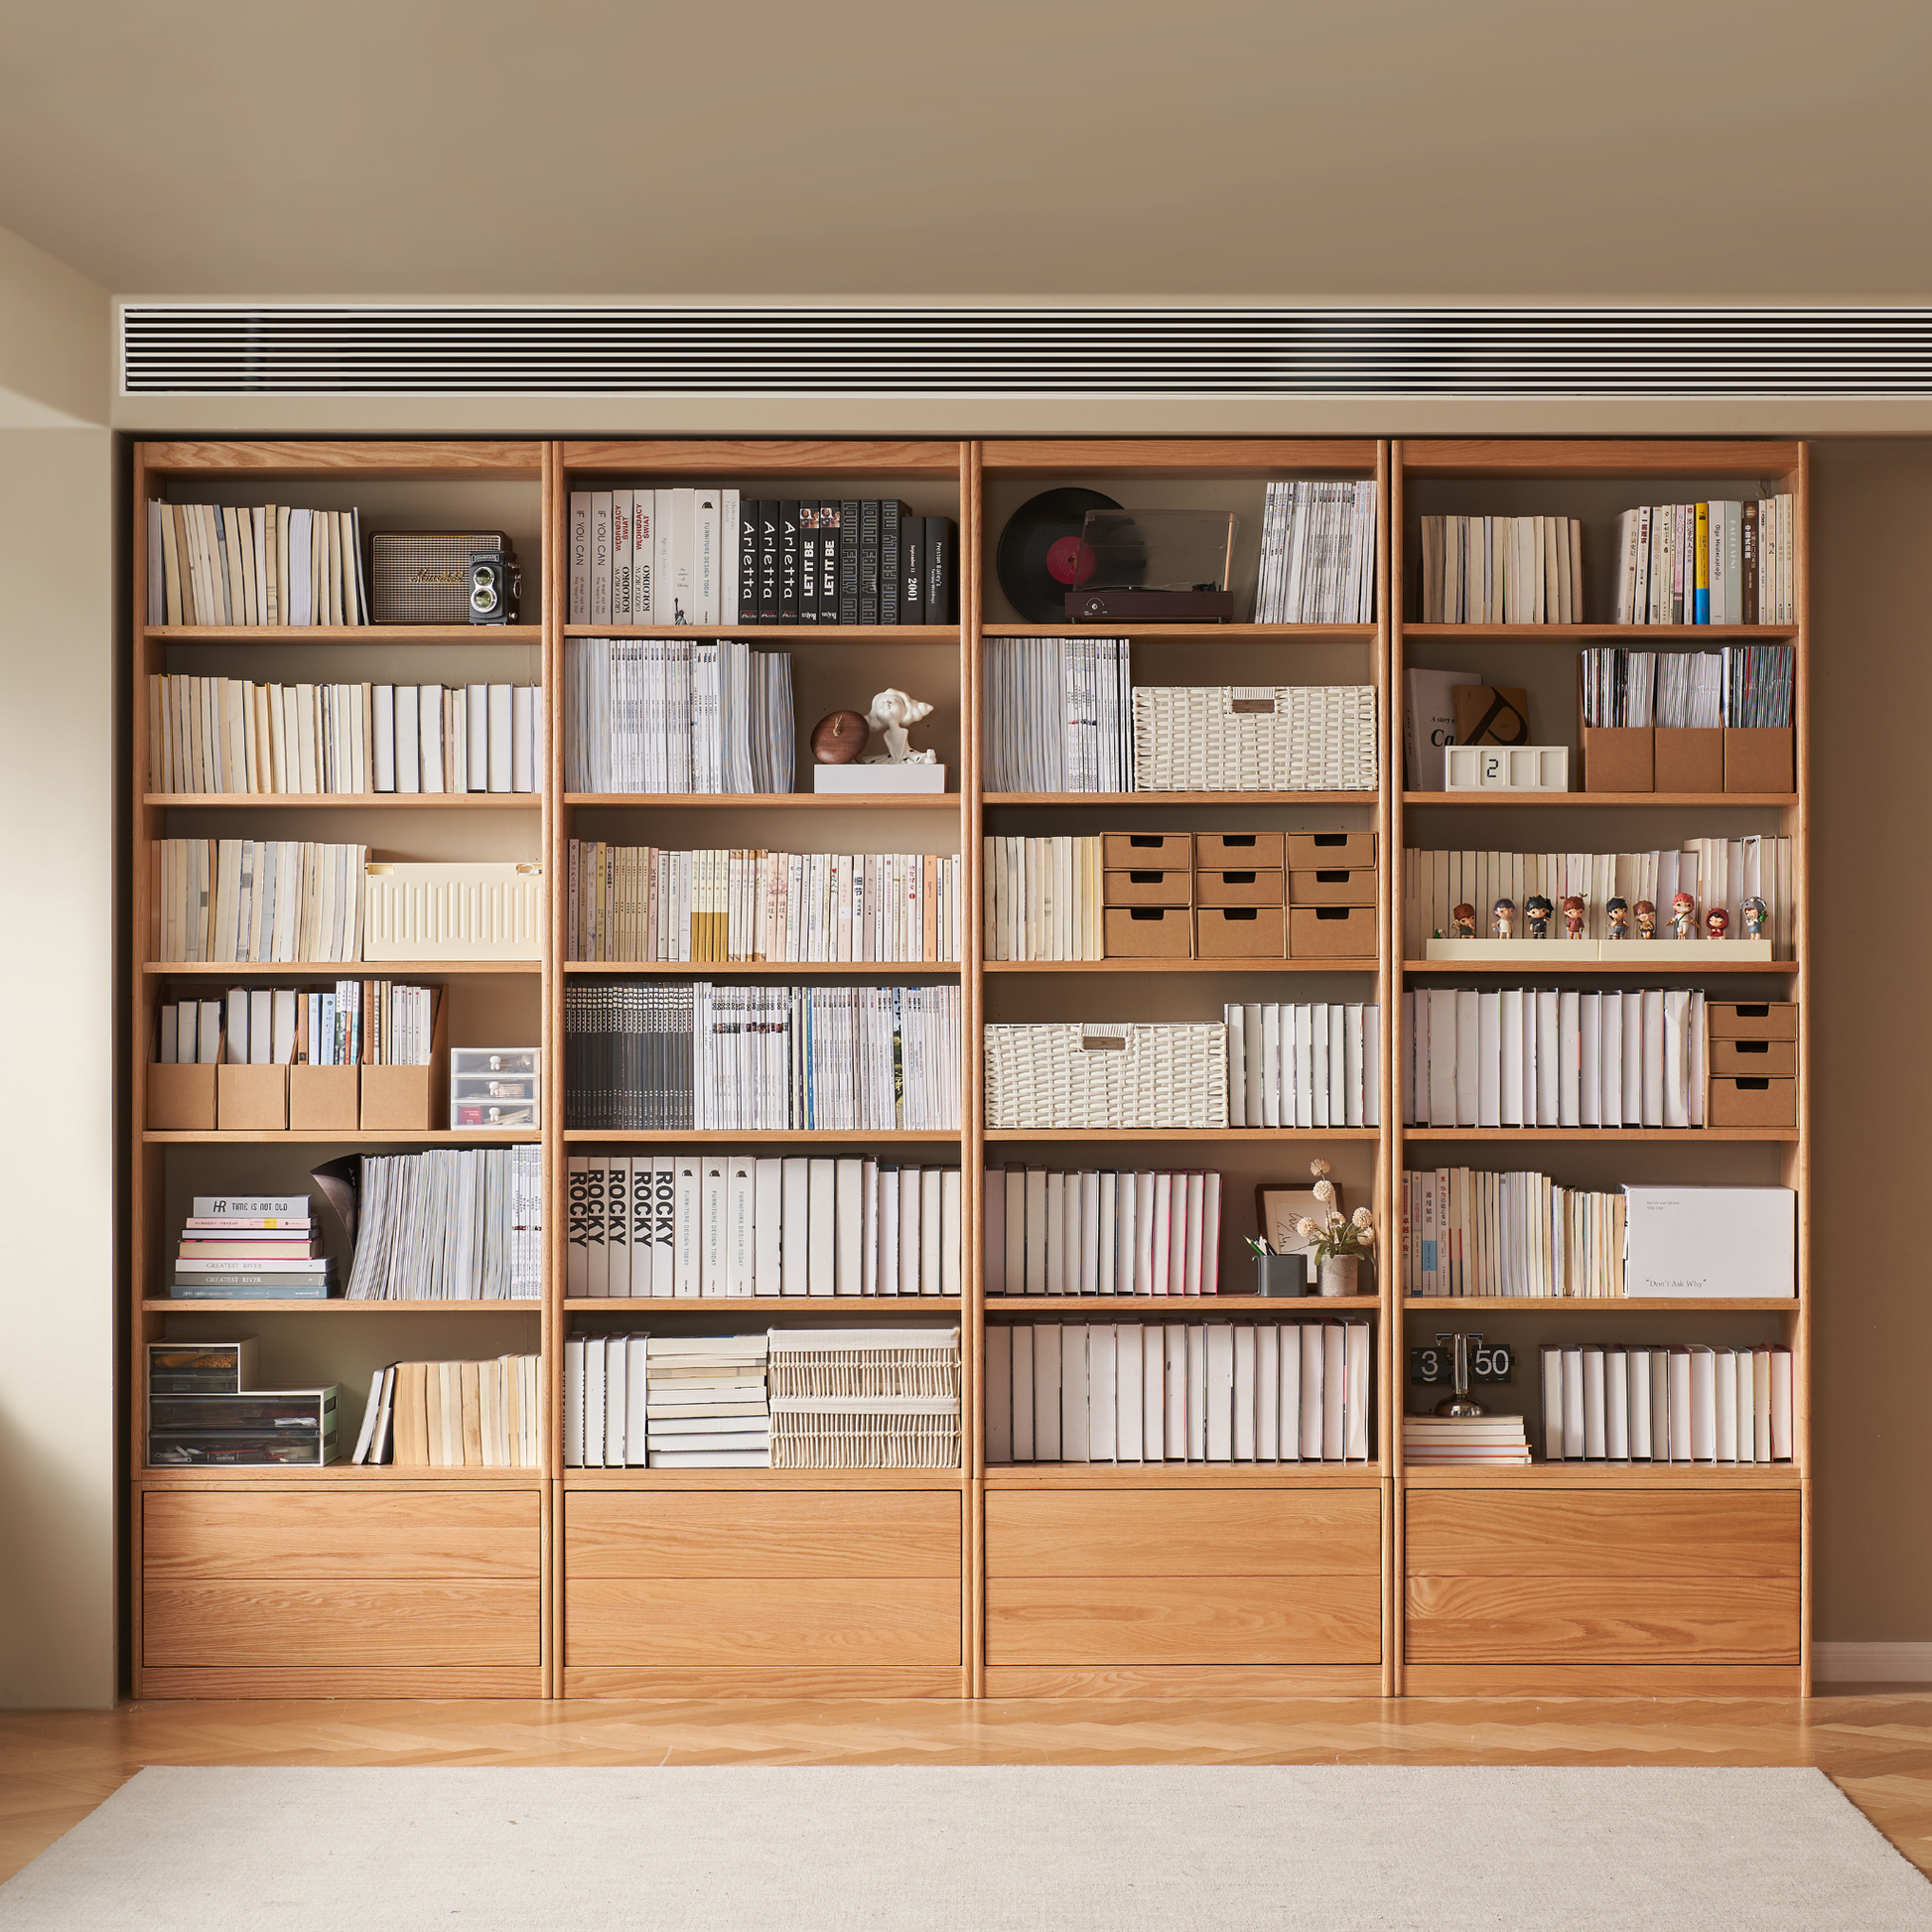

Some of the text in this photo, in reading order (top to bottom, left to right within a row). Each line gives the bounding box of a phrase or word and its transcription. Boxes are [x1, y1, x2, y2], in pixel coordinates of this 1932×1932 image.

[575, 522, 585, 542] YOU
[597, 522, 607, 542] YOU
[842, 501, 857, 544] LOVING
[862, 501, 878, 544] LOVING
[882, 501, 897, 530] MAN
[575, 545, 585, 566] CAN
[597, 545, 607, 566] CAN
[743, 521, 756, 600] Arletta
[763, 521, 776, 600] Arletta
[783, 521, 796, 600] Arletta
[803, 541, 814, 597] LET IT BE
[824, 540, 835, 597] LET IT BE
[842, 549, 857, 594] FAMILY
[862, 549, 878, 594] FAMILY
[882, 534, 897, 580] FAMILY
[642, 565, 651, 612] KOŁODKO
[907, 578, 917, 602] 2001
[1431, 729, 1456, 747] Ca
[1437, 716, 1450, 725] story
[1487, 759, 1499, 778] 2
[854, 876, 863, 897] 细节
[232, 1202, 248, 1211] TIME
[251, 1202, 258, 1211] IS
[259, 1202, 272, 1211] NOT
[274, 1202, 288, 1211] OLD
[570, 1172, 588, 1248] ROCKY
[588, 1170, 605, 1246] ROCKY
[609, 1170, 625, 1246] ROCKY
[633, 1171, 652, 1248] ROCKY
[656, 1172, 673, 1248] ROCKY
[1421, 1349, 1509, 1376] 3 50
